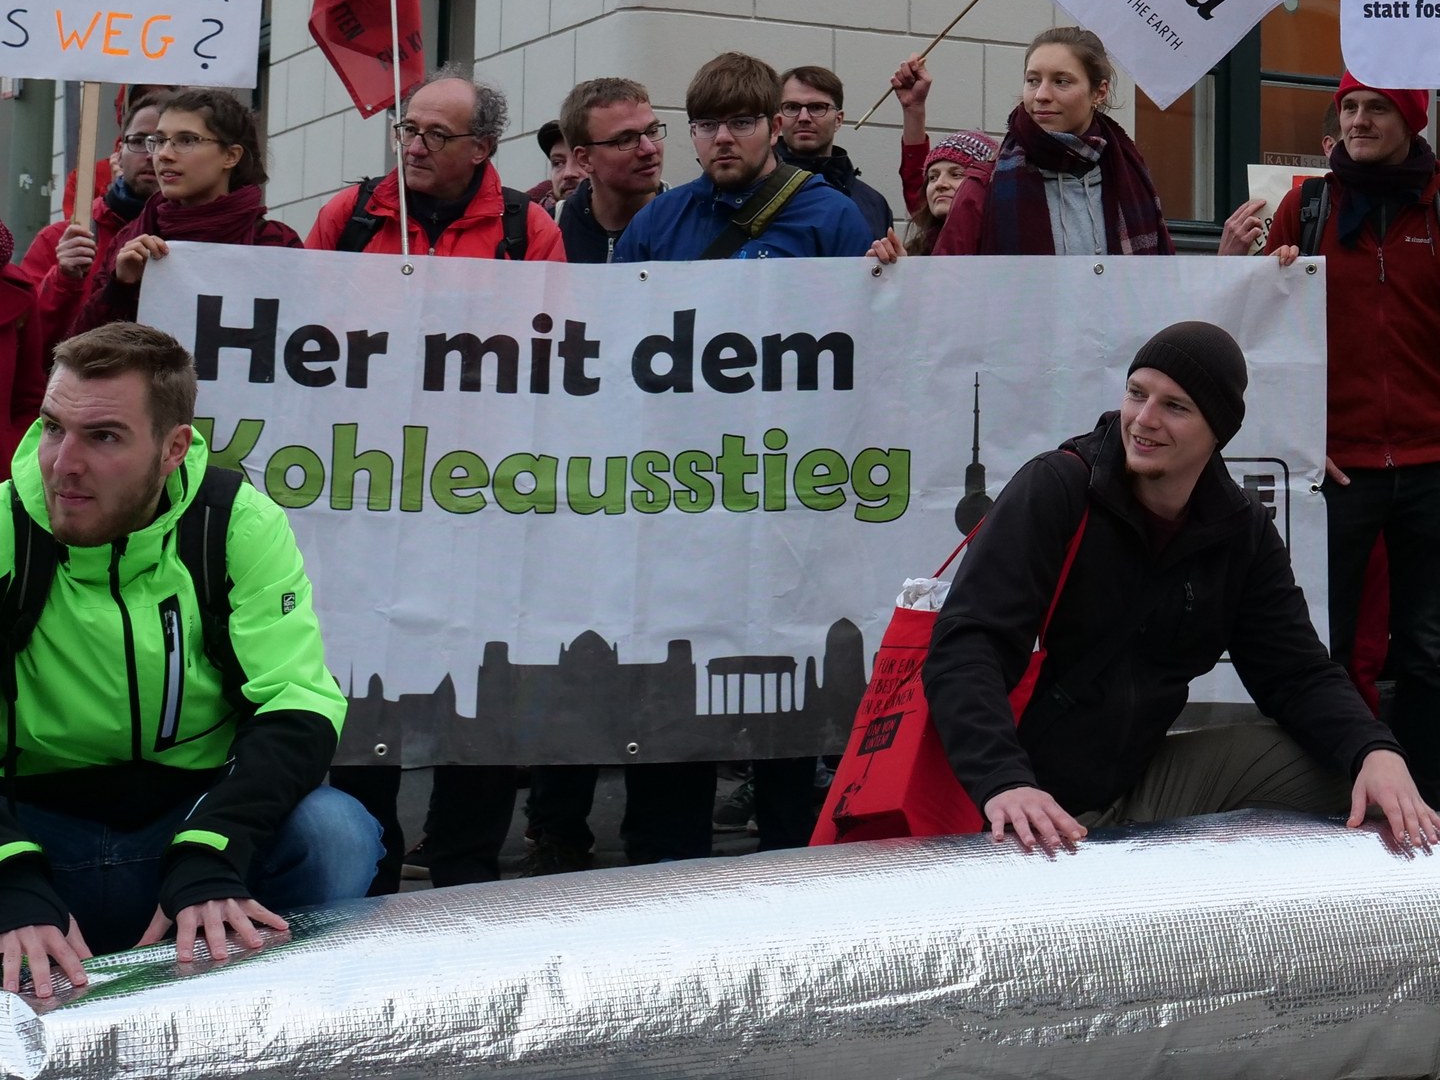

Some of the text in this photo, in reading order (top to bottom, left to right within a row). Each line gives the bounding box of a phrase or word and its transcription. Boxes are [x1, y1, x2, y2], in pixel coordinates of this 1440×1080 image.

[1146, 12, 1184, 52] EARTH
[1363, 0, 1410, 19] statt
[55, 9, 175, 60] WEG
[193, 18, 224, 70] ?
[193, 296, 854, 397] Her mit dem
